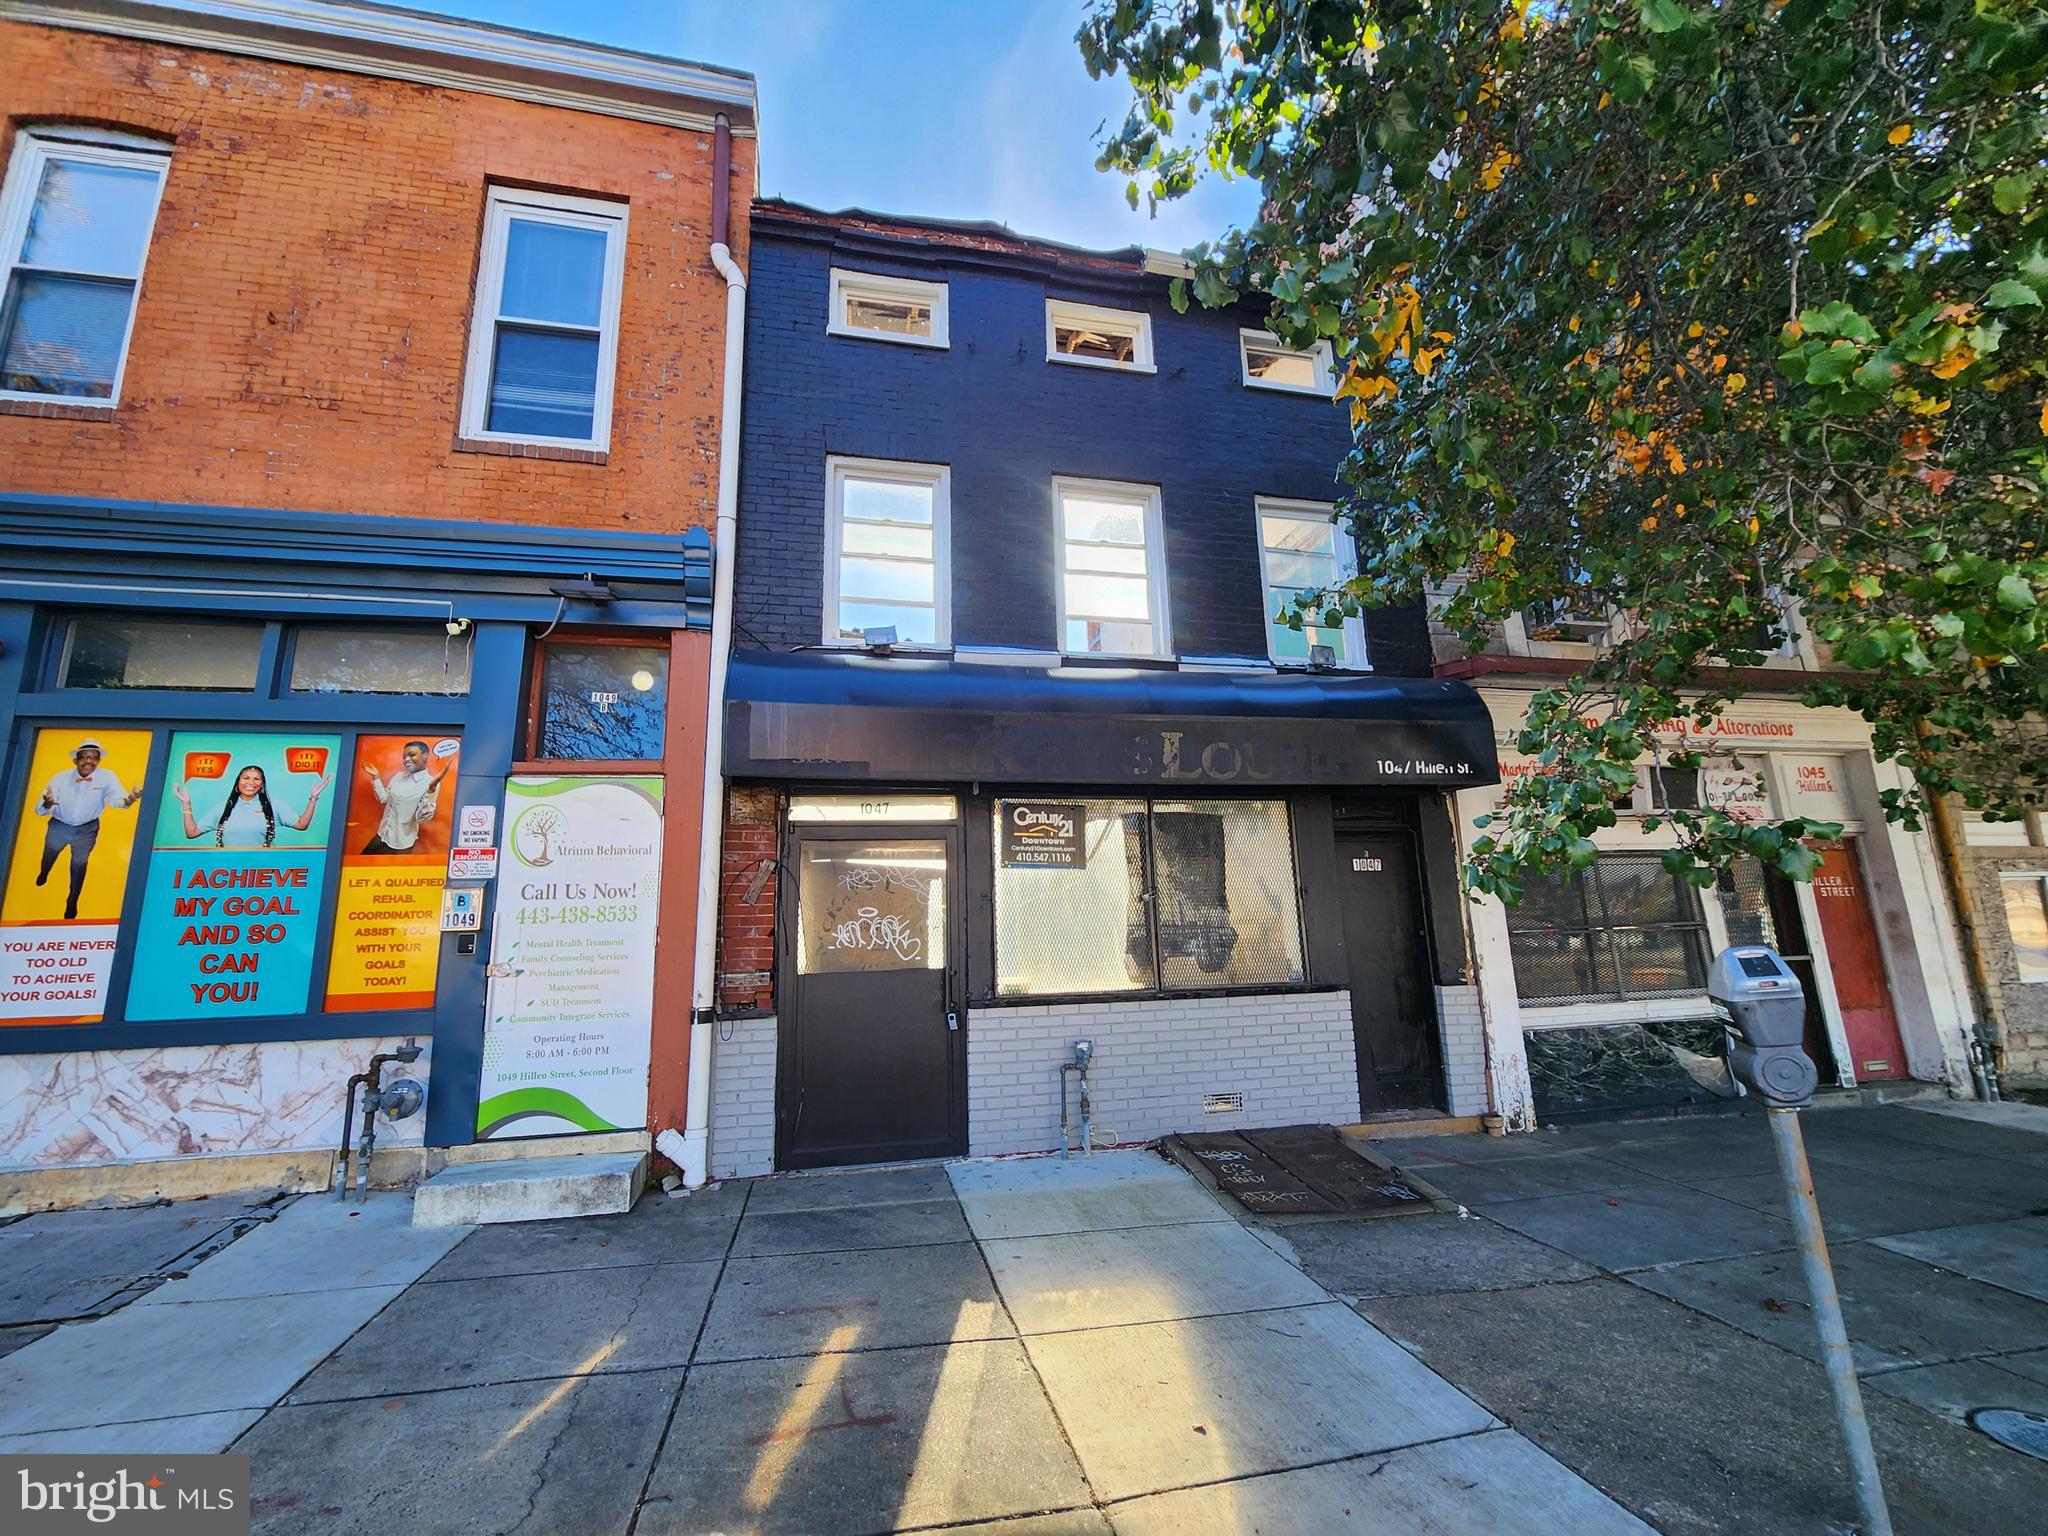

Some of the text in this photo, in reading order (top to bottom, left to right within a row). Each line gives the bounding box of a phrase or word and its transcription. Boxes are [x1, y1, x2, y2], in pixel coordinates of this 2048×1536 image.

[593, 693, 617, 703] 1049
[1709, 717, 1794, 737] Alterations
[196, 766, 214, 774] YES
[295, 761, 310, 769] DID
[313, 761, 321, 769] IT
[1797, 766, 1826, 779] 1045
[1796, 780, 1827, 794] Hillen
[860, 802, 890, 815] 1047
[1013, 807, 1074, 837] Century 21
[556, 844, 652, 856] Atrium Behavioral
[1016, 852, 1072, 862] 410.547.1116
[1353, 859, 1382, 871] 1047
[173, 869, 308, 888] I ACHIEVE
[349, 878, 445, 888] LET A QUALIFIED
[521, 883, 637, 900] Call Us Now!
[1821, 887, 1856, 897] STREET
[373, 895, 416, 903] REHAB.
[458, 896, 467, 907] B
[174, 896, 300, 917] MY GOAL
[349, 911, 433, 920] COORDINATOR
[446, 914, 476, 927] 1049
[515, 905, 638, 925] 443-438-8533
[178, 924, 286, 945] AND SO
[354, 927, 426, 937] ASSIST YOU
[4, 941, 115, 952] YOU ARE NEVER
[357, 944, 422, 953] WITH YOUR
[526, 938, 624, 949] Mental Health Treatment
[26, 957, 87, 968] TOO OLD
[199, 953, 259, 974] CAN
[521, 952, 629, 964] Family Counseling Services
[365, 960, 406, 970] GOALS
[529, 967, 620, 978] Psychiatric Medication
[12, 973, 95, 985] TO ACHIEVE
[364, 977, 407, 986] TODAY!
[191, 982, 259, 1003] YOU!
[548, 983, 599, 993] Management
[1, 989, 97, 1002] YOUR GOALS!
[540, 997, 602, 1007] SUD Treatment
[509, 1010, 630, 1023] Community Integrate Services
[533, 1032, 605, 1045] Operating Hours
[526, 1049, 546, 1059] 8:00
[548, 1048, 564, 1058] AM
[573, 1047, 592, 1056] 6:00
[594, 1046, 610, 1055] PM
[497, 1066, 634, 1082] 1049 Hillen Street, Second Floor
